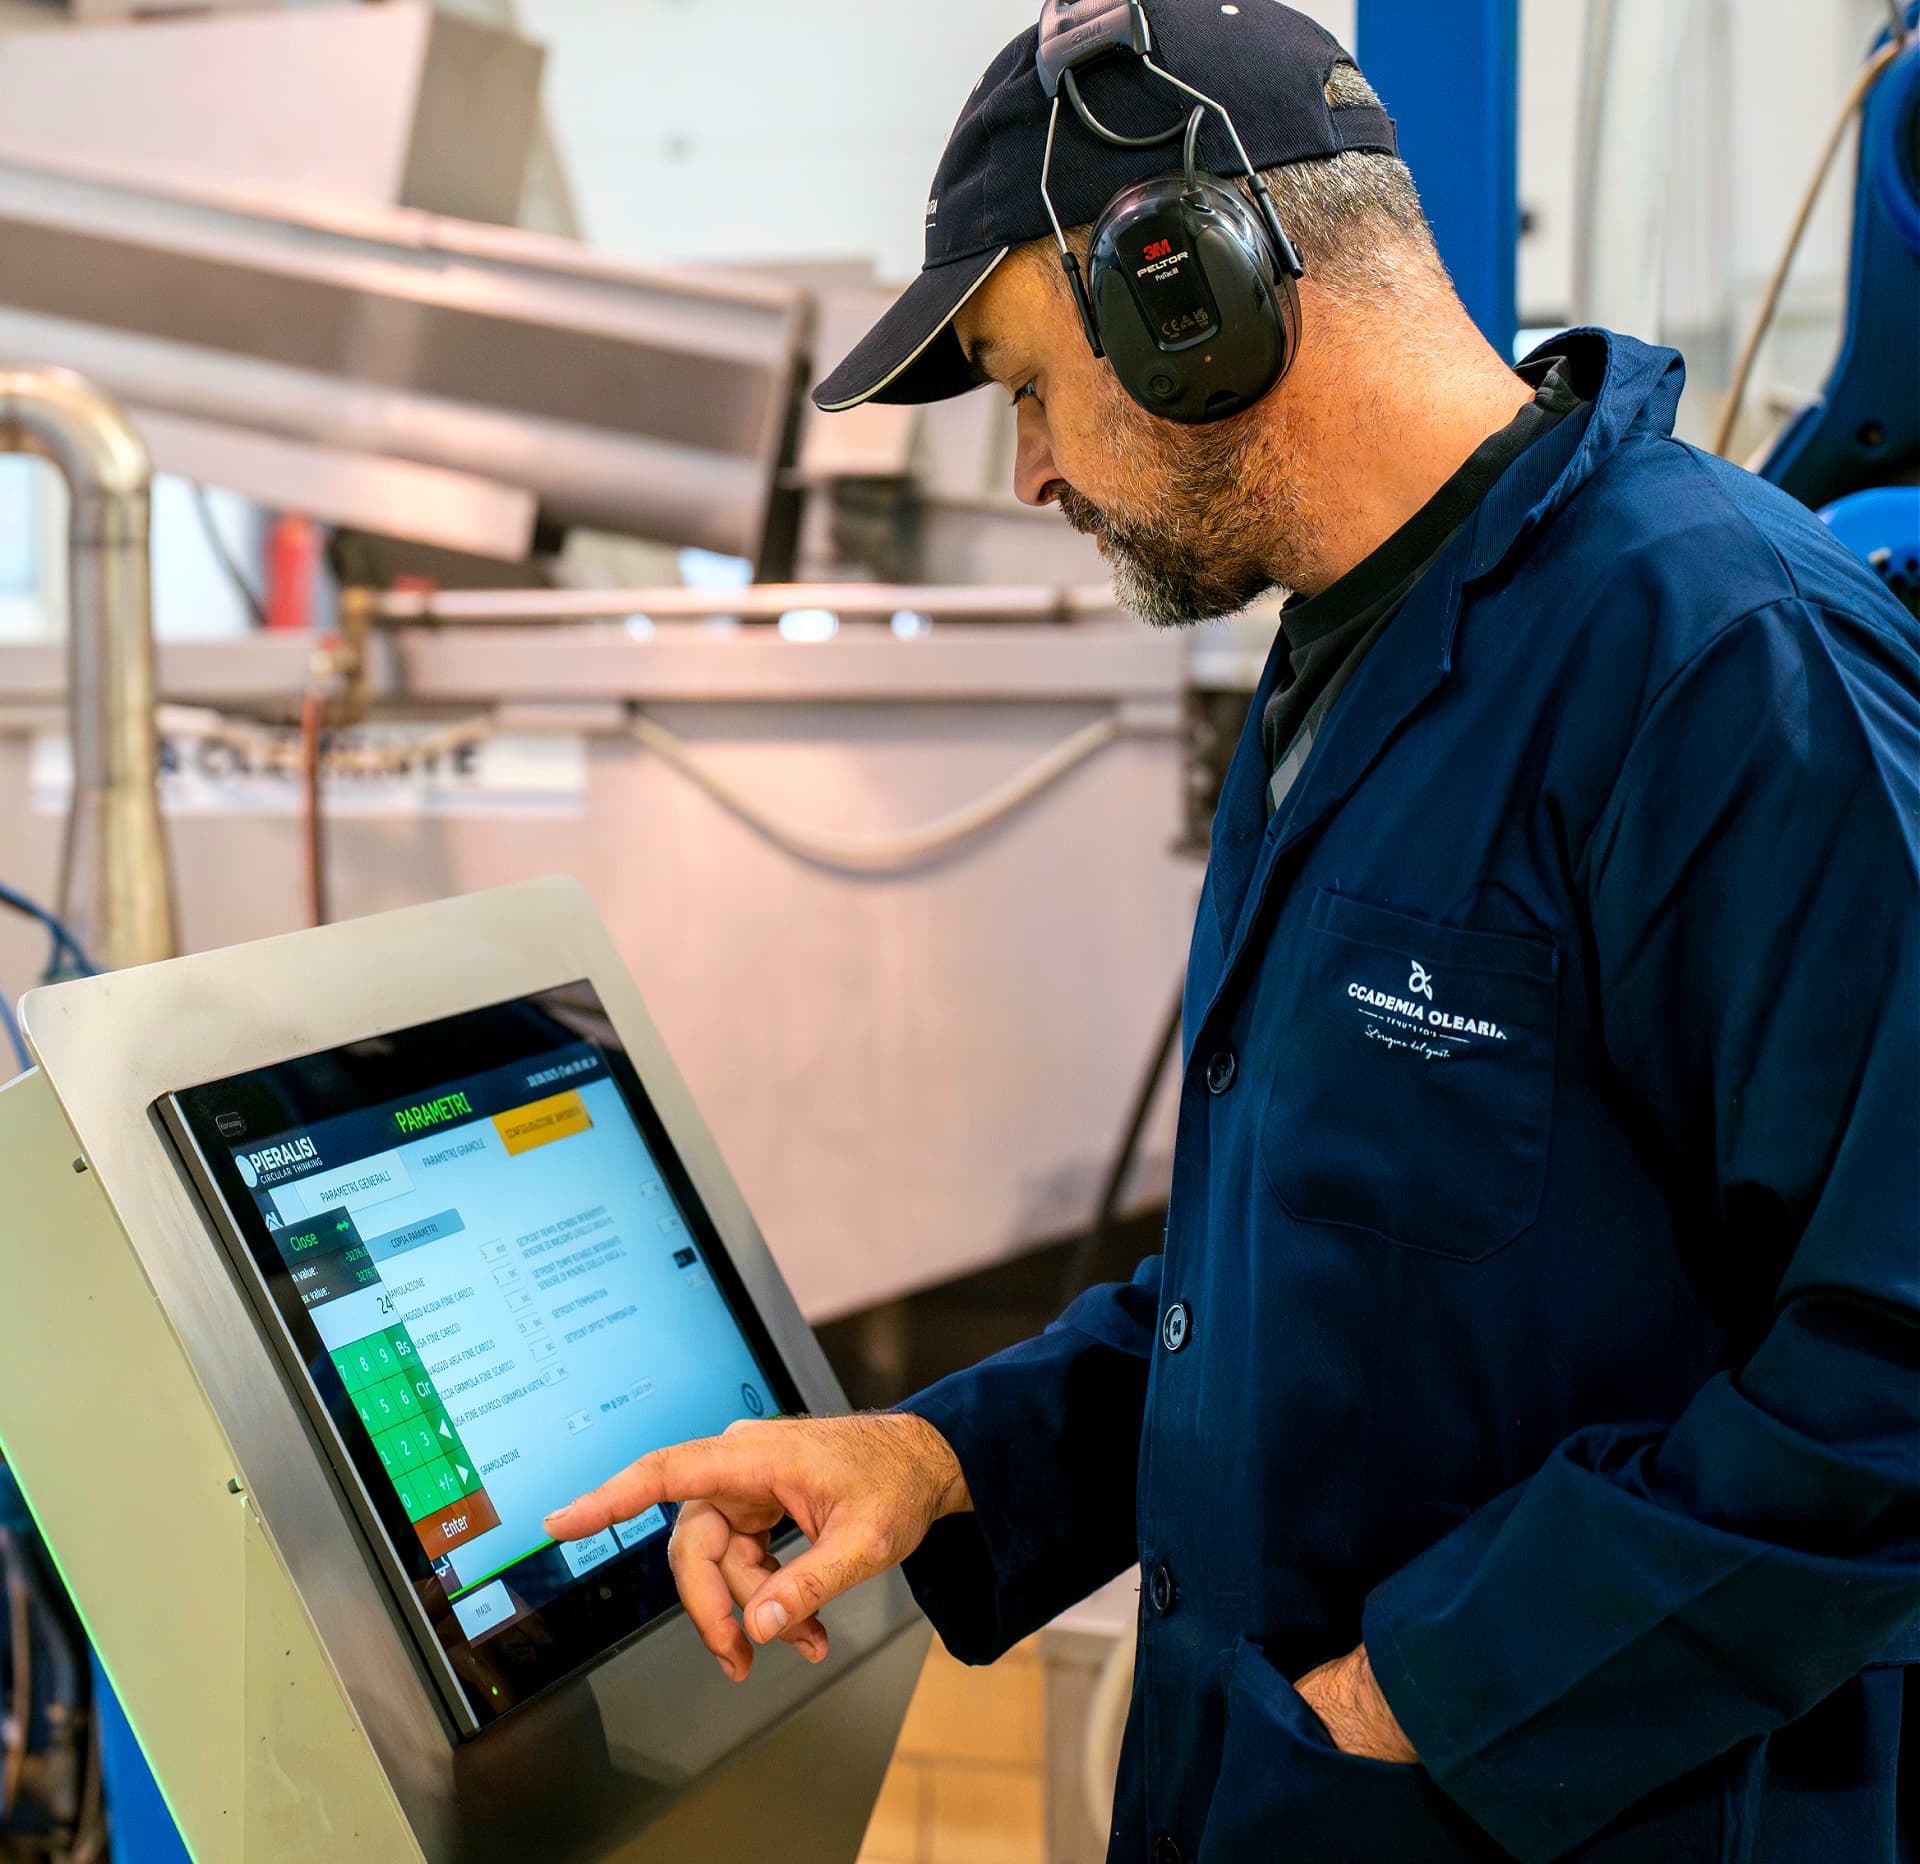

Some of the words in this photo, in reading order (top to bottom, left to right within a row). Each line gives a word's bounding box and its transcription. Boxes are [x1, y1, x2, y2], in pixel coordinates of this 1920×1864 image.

[1143, 239, 1172, 261] 3M
[1136, 250, 1189, 278] PELTOR
[395, 1092, 473, 1134] PARAMETRI
[248, 1136, 318, 1174] PIERALISI
[422, 1147, 458, 1168] PARAMETRI
[260, 1168, 293, 1184] CIRCULAR
[293, 1157, 323, 1175] THINKING
[320, 1180, 359, 1203] PARAMETRI
[357, 1170, 392, 1190] GENERALI
[289, 1232, 319, 1252] Close
[391, 1234, 410, 1249] COPIA
[407, 1223, 439, 1241] PARAMETRI
[376, 1294, 394, 1315] 24
[425, 1331, 440, 1344] FINE
[378, 1348, 389, 1363] 9
[396, 1340, 411, 1356] Bs
[460, 1347, 475, 1360] FINE
[338, 1365, 348, 1381] 7
[359, 1356, 369, 1372] 8
[416, 1380, 431, 1398] Clr
[454, 1375, 480, 1395] GRAMOLA
[478, 1370, 493, 1383] FINE
[379, 1398, 390, 1413] 5
[400, 1390, 410, 1405] 6
[362, 1407, 370, 1422] 4
[464, 1408, 479, 1422] FINE
[477, 1397, 502, 1416] SCARICO
[400, 1440, 411, 1456] 2
[420, 1431, 430, 1447] 3
[381, 1450, 391, 1465] 1
[479, 1447, 521, 1477] GRAMOLAZIONE
[402, 1493, 412, 1508] 0
[442, 1515, 469, 1538] Enter
[578, 1544, 609, 1567] FRANGITORI
[475, 1603, 493, 1618] MAIN
